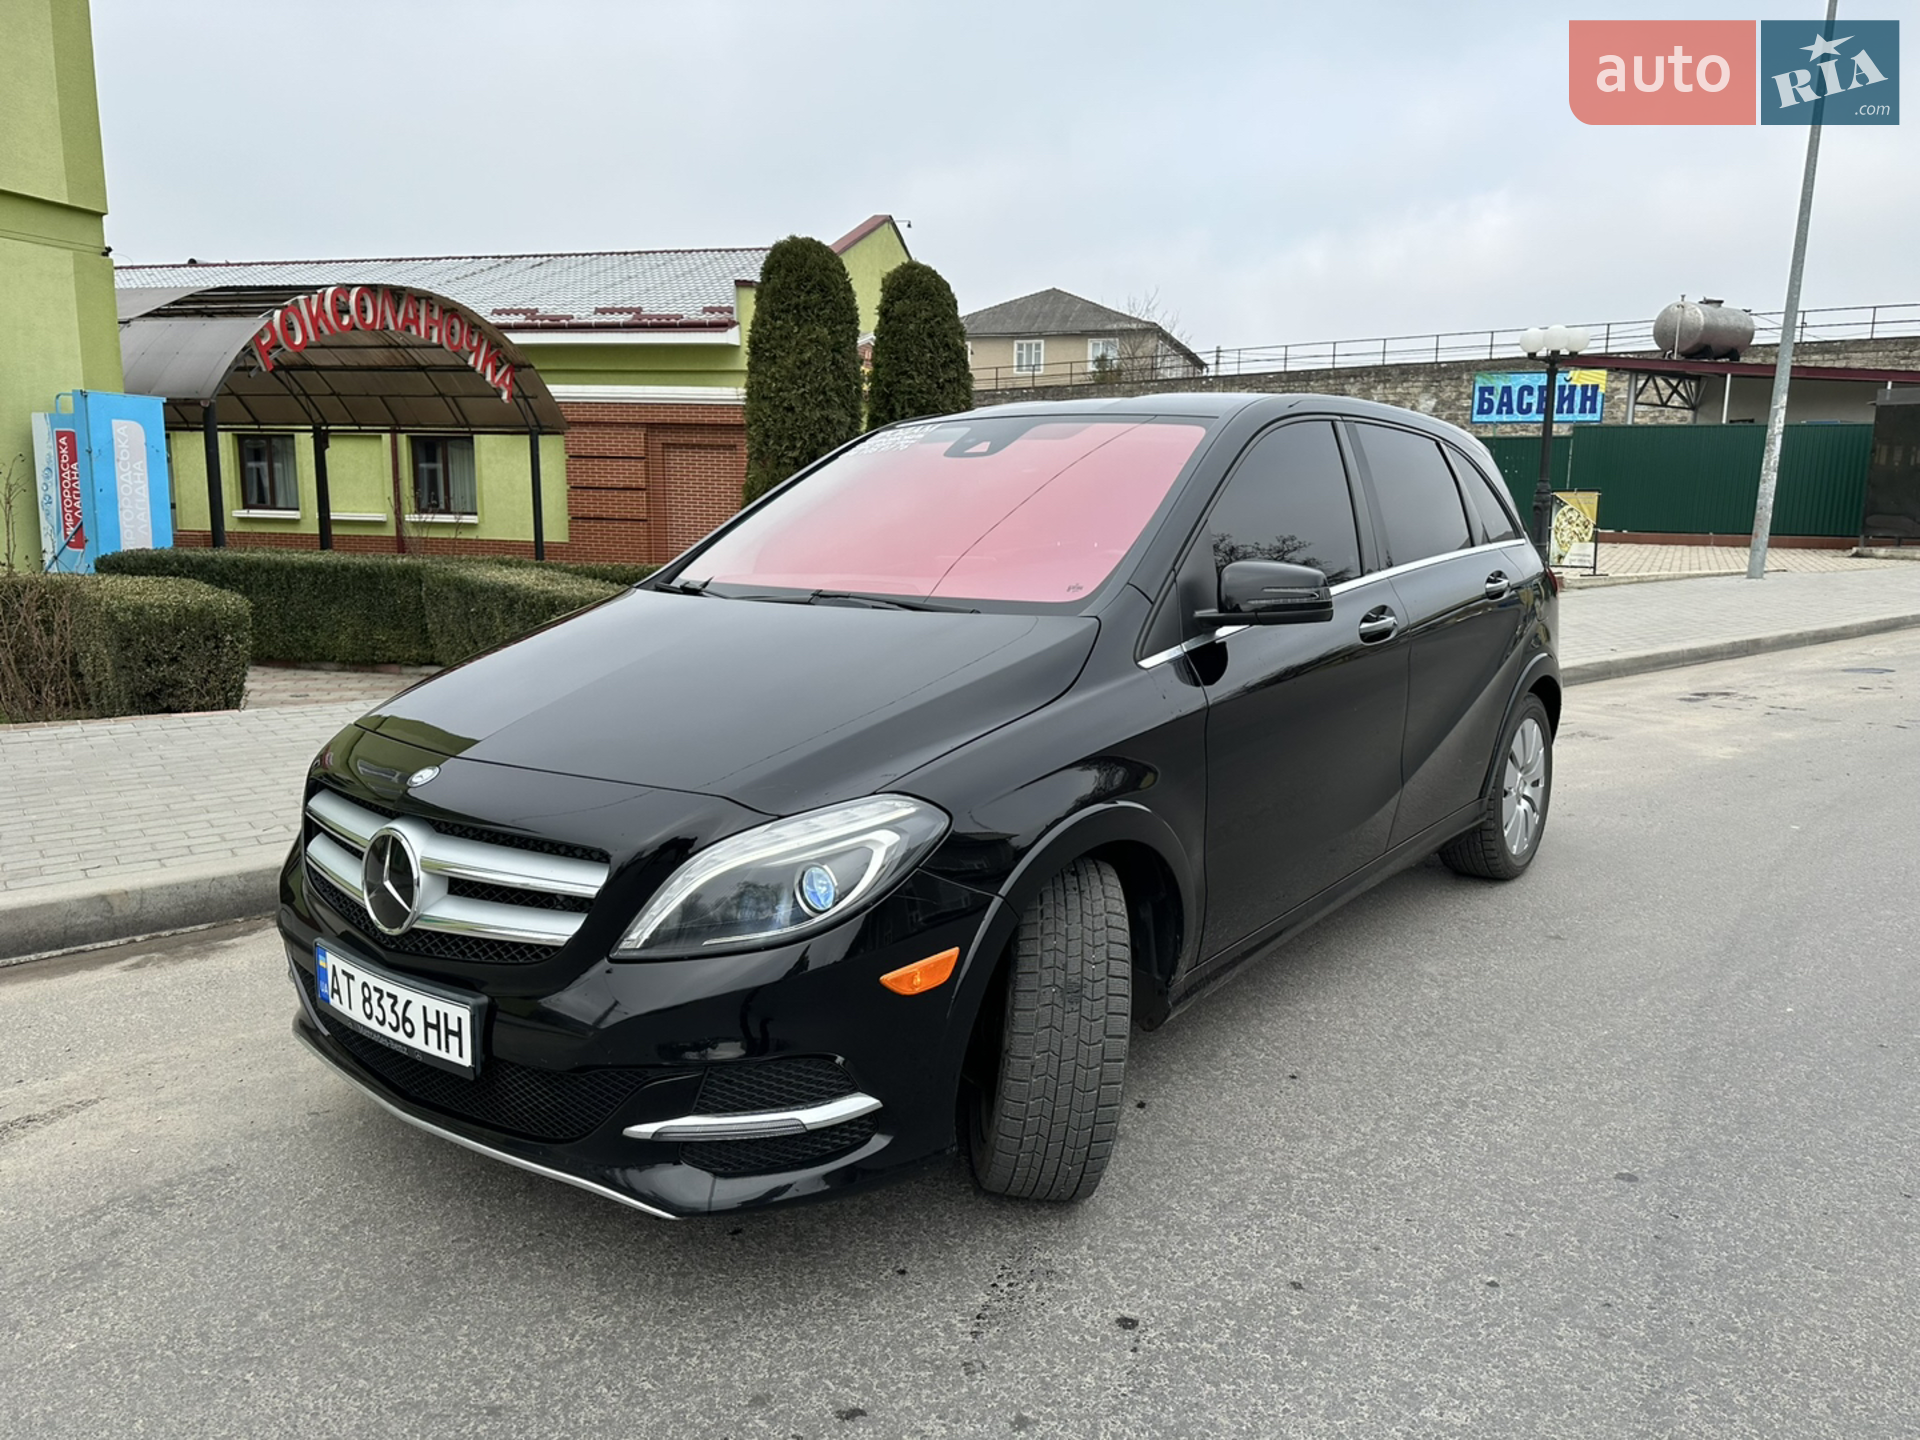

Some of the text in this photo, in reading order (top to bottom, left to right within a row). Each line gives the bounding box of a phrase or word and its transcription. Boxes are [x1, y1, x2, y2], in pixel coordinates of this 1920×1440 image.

[252, 286, 515, 403] РОКСОЛАНОЧКА
[117, 425, 136, 549] ИРГОРОДСЬКА
[331, 964, 463, 1058] AT 8336 HH
